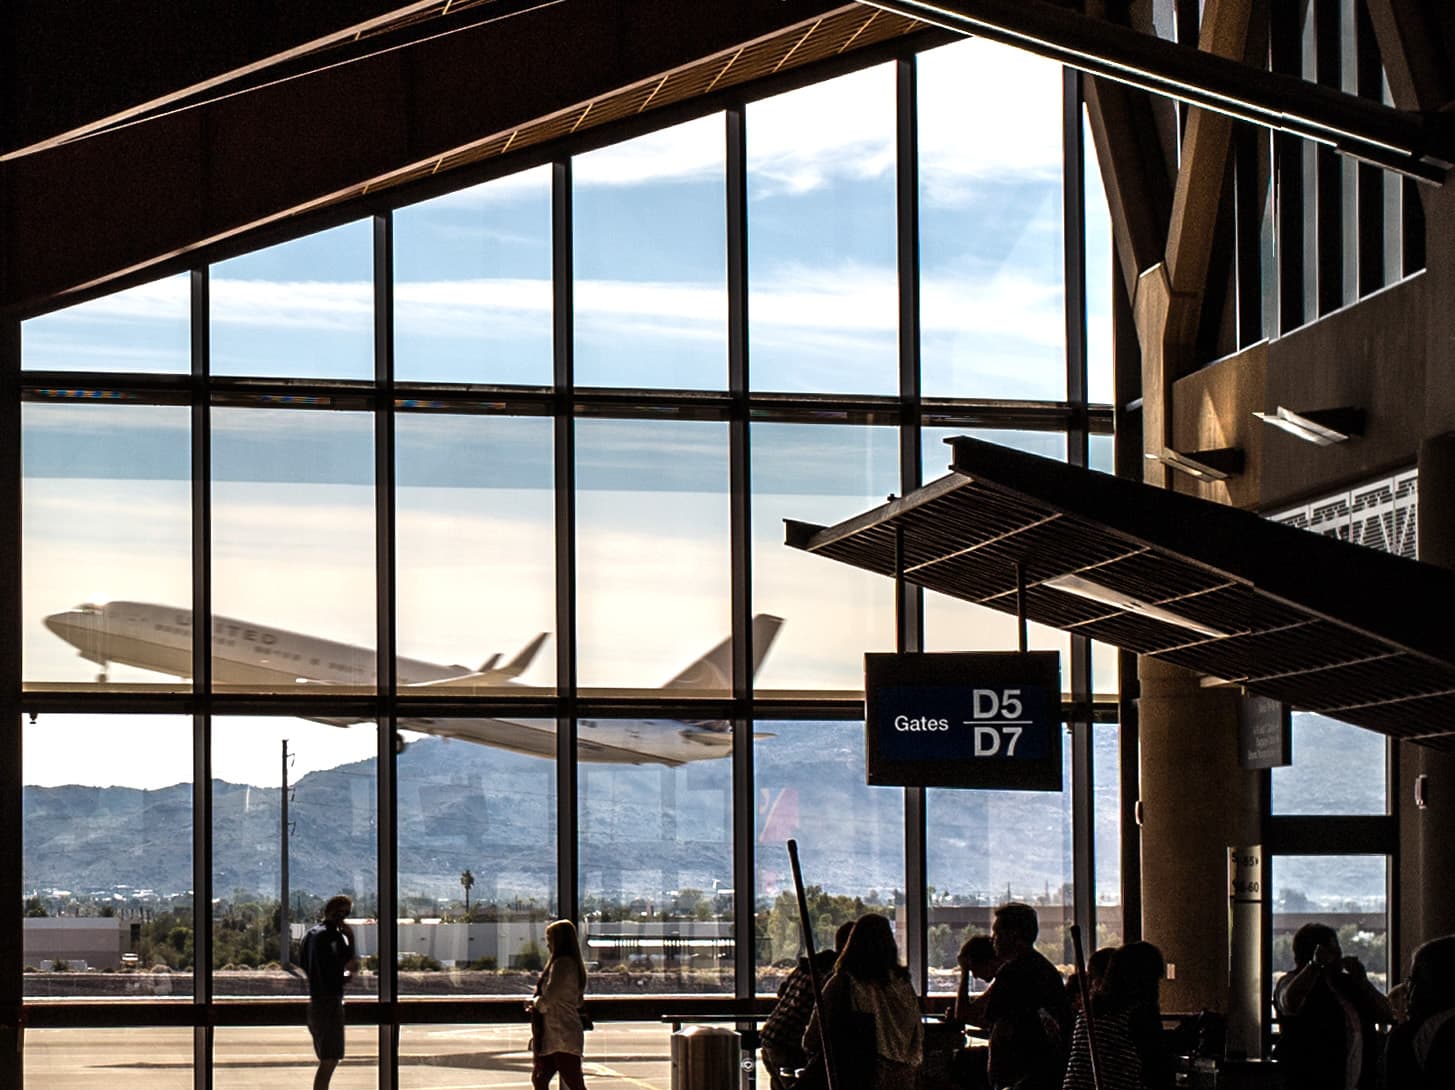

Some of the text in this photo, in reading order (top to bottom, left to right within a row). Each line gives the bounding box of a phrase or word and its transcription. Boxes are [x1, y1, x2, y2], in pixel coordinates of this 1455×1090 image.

[174, 613, 277, 645] UITED
[972, 689, 1023, 719] D5
[894, 715, 949, 732] Gates
[973, 726, 1023, 757] D7
